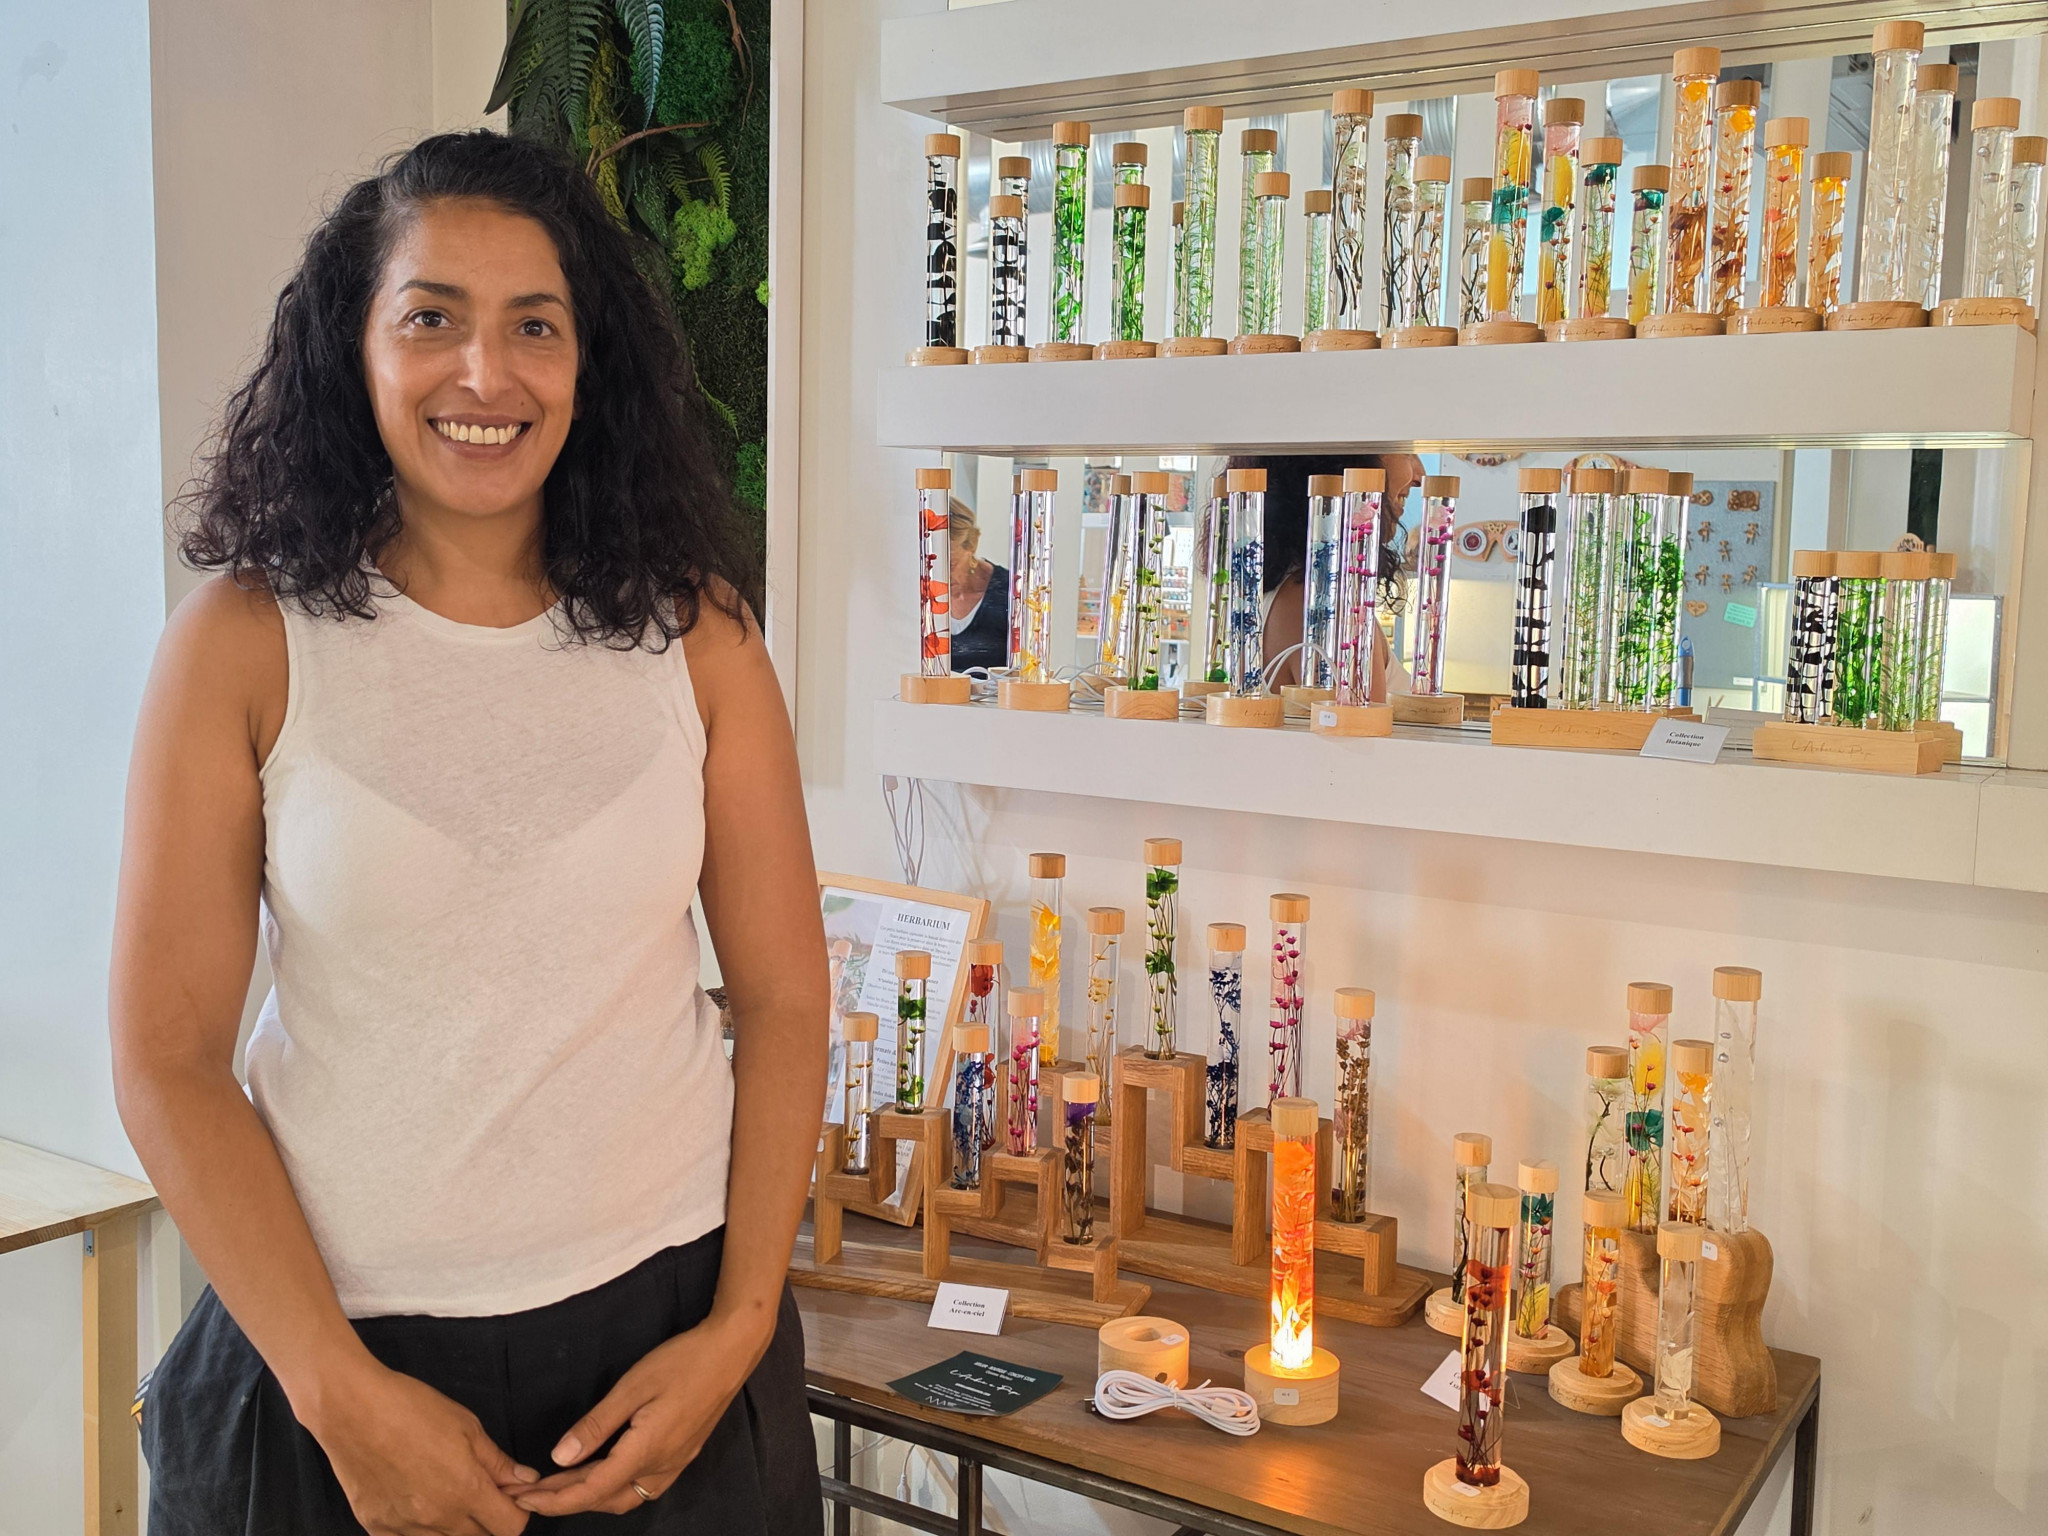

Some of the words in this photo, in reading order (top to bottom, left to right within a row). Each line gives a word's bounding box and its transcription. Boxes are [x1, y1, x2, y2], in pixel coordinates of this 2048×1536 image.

[1669, 731, 1704, 741] Collection
[1665, 738, 1702, 748] Botanique
[897, 913, 951, 931] HERBARIUM
[952, 1298, 985, 1309] Collection
[949, 1306, 985, 1318] Arc-en-ciel
